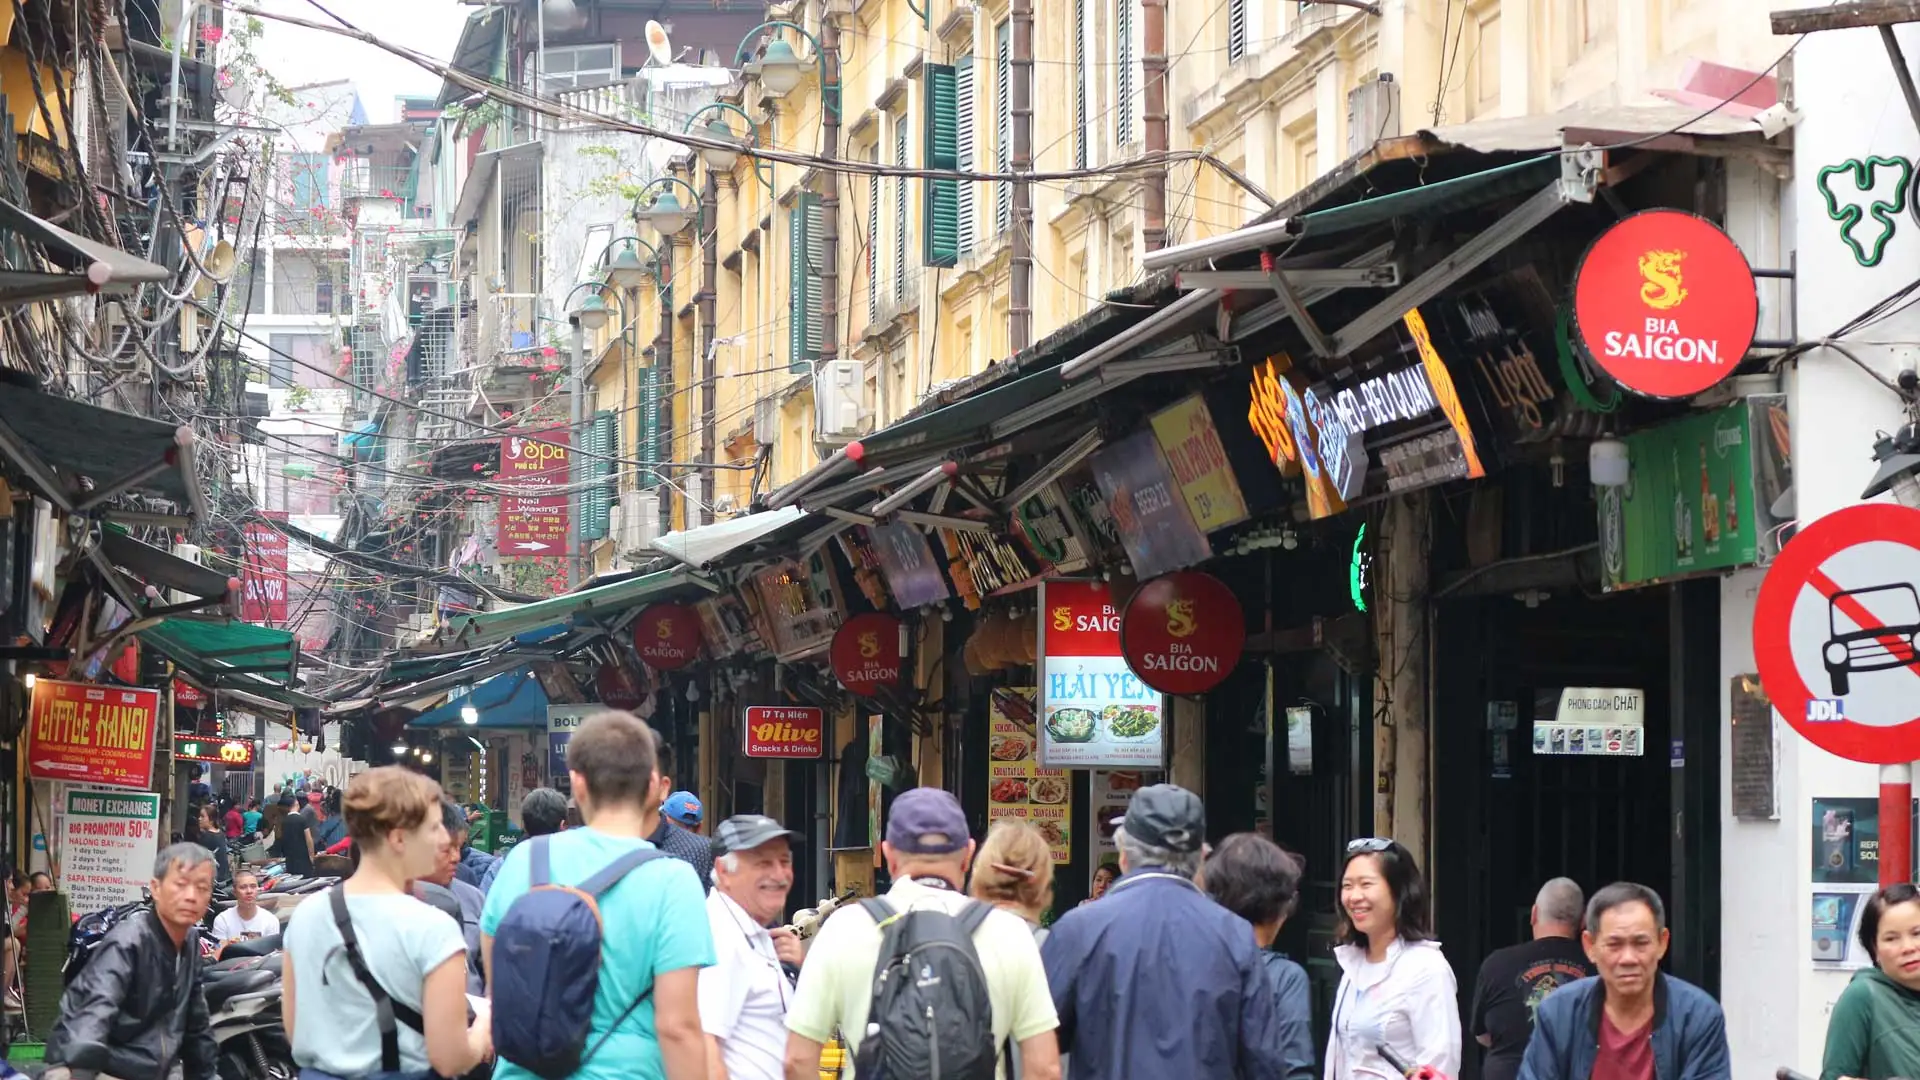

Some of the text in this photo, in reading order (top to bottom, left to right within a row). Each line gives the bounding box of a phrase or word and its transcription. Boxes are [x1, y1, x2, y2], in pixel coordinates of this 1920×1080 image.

[1644, 317, 1680, 335] BIA
[1605, 331, 1718, 364] SAIGON
[1477, 337, 1555, 428] Light
[523, 441, 565, 469] Spa
[517, 505, 559, 514] Waxing
[1102, 604, 1118, 615] BI
[1076, 614, 1121, 632] SAIG
[643, 648, 685, 658] SAIGON
[1170, 643, 1193, 654] BIA
[864, 661, 881, 669] BIA
[1143, 653, 1219, 672] SAIGON
[846, 667, 899, 682] SAIGON
[176, 693, 204, 701] SAIGO
[1568, 698, 1592, 710] PHONG
[762, 710, 772, 718] 17
[37, 699, 149, 752] LITTLE HANOI
[751, 722, 819, 742] Olive
[751, 744, 781, 752] Snacks
[72, 797, 153, 816] MONEY EXCHANGE
[69, 820, 153, 840] BIG PROMOTION 50%
[68, 838, 99, 847] HALONG
[78, 864, 95, 872] days
[67, 873, 86, 882] SAPA
[87, 875, 123, 885] TREKKING
[76, 893, 94, 901] days
